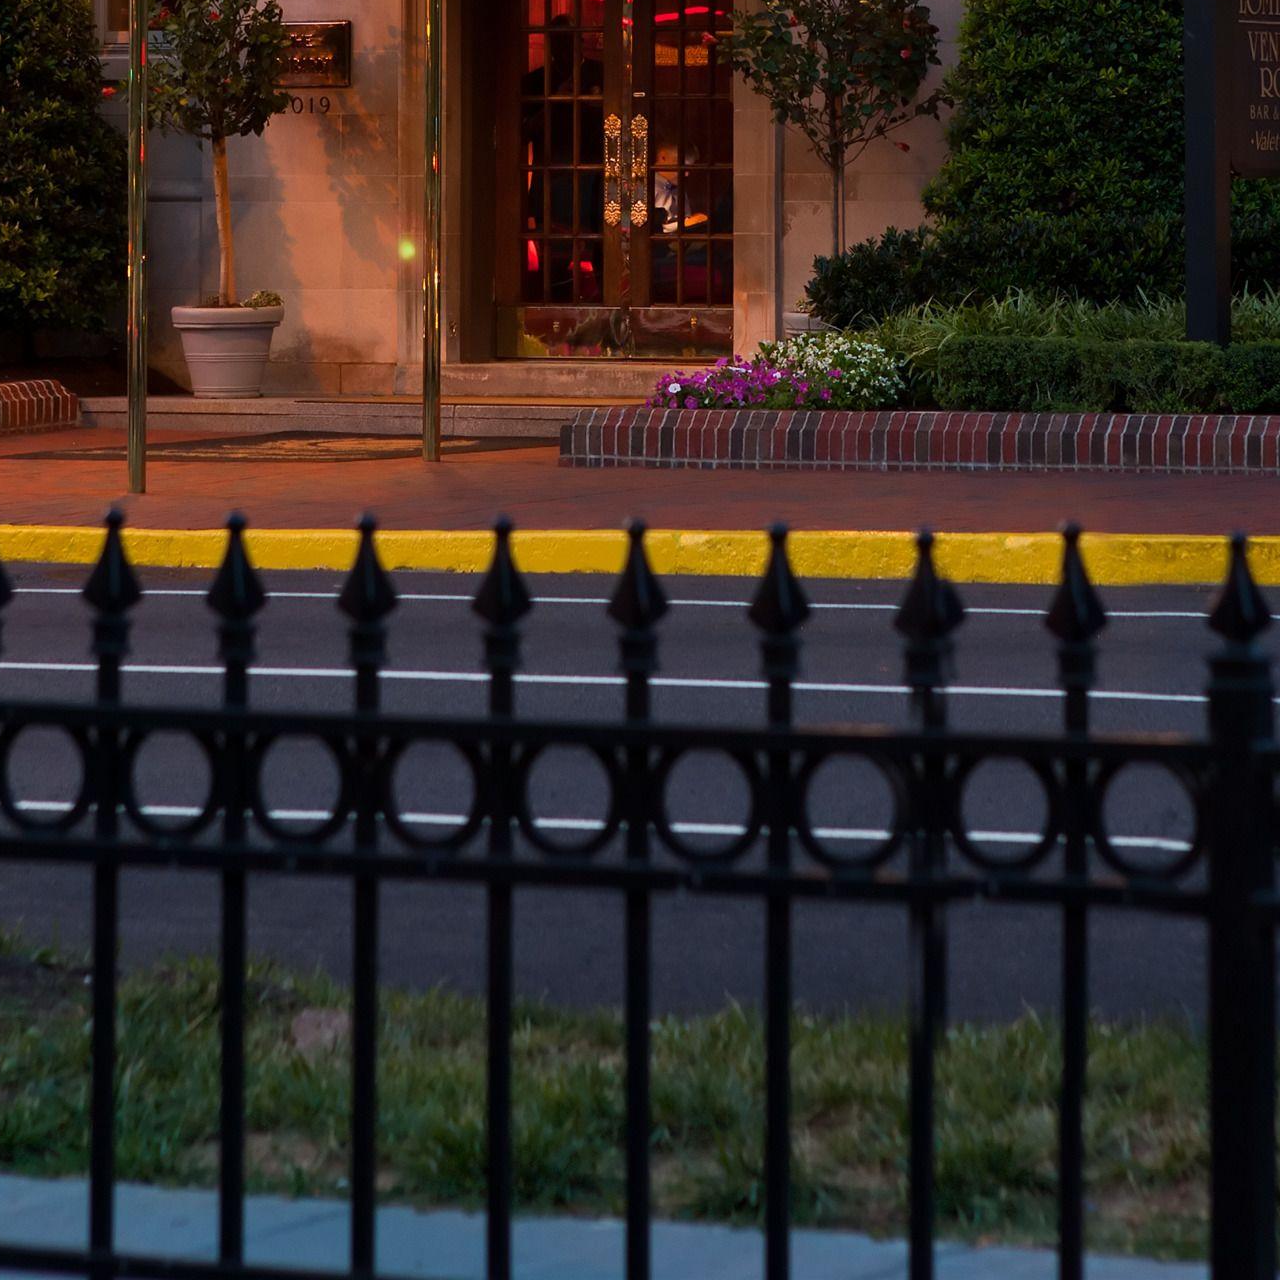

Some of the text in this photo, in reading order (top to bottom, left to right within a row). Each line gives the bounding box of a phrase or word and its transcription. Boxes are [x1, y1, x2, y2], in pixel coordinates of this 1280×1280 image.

[283, 96, 330, 114] 019
[1249, 105, 1269, 120] BAR
[1273, 106, 1280, 120] &
